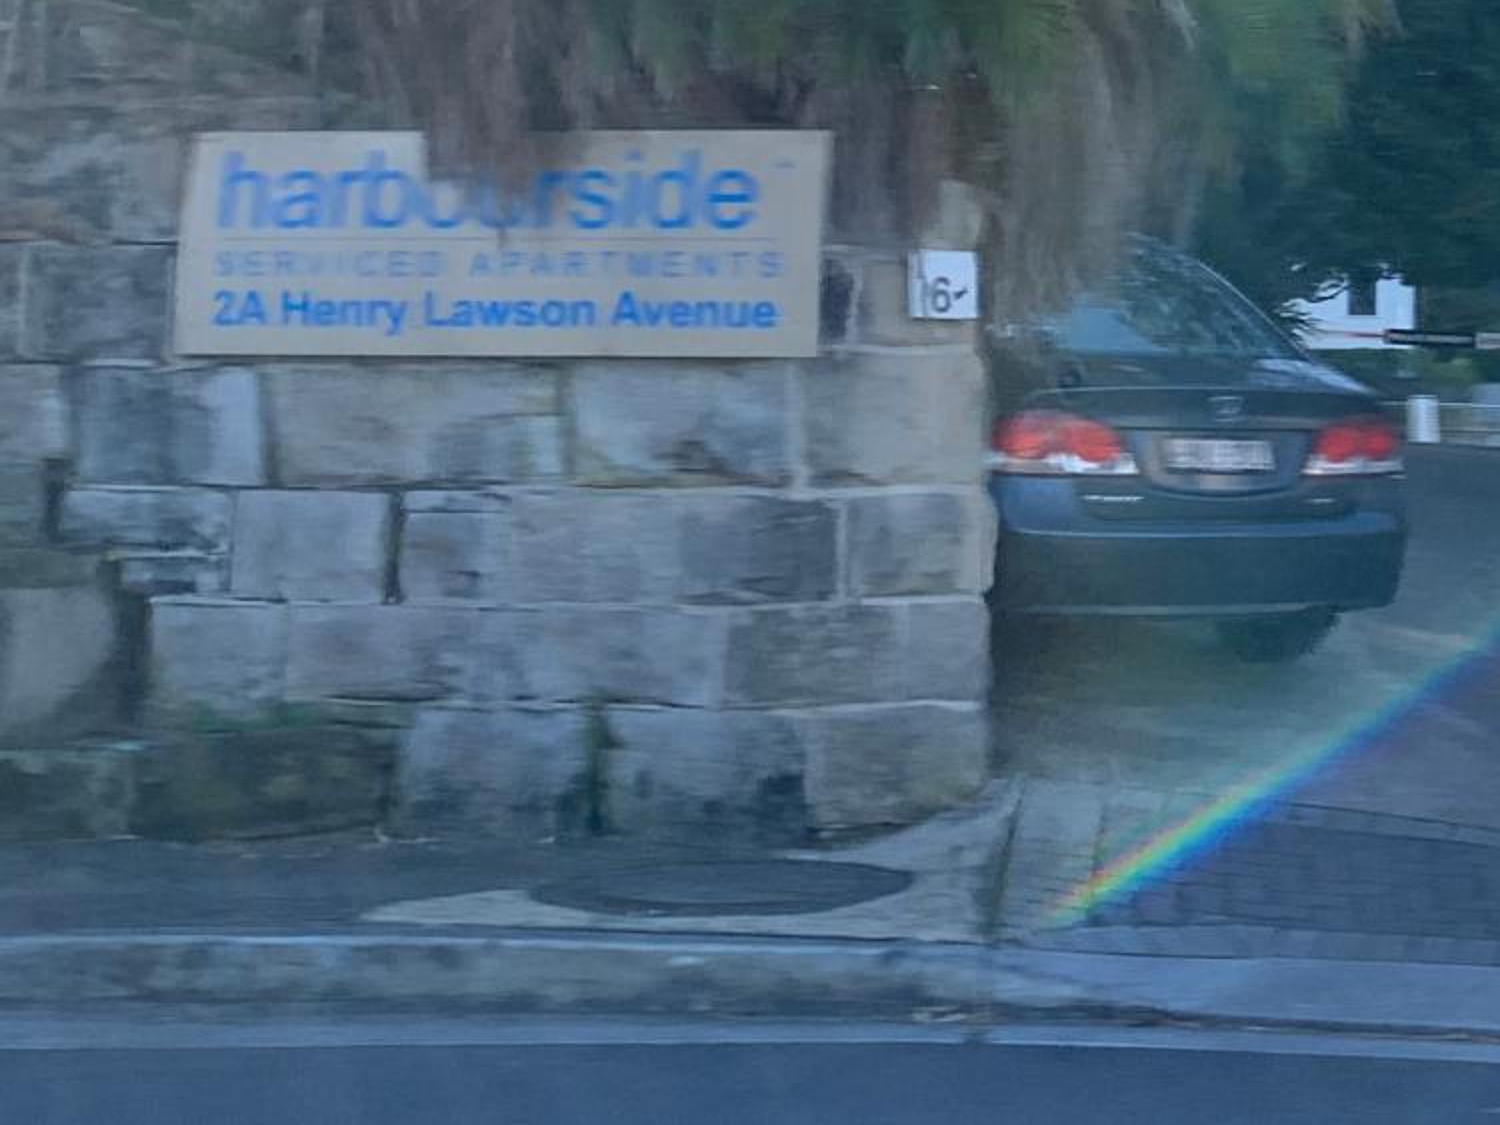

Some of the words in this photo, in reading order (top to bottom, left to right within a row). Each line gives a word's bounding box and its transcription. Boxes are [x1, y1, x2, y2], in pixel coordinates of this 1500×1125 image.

[216, 150, 759, 229] harbourside
[470, 250, 784, 277] APARTMENTS
[213, 290, 266, 327] 2A
[281, 291, 407, 334] Henry
[424, 291, 597, 328] Lawson
[611, 290, 777, 328] Avenue
